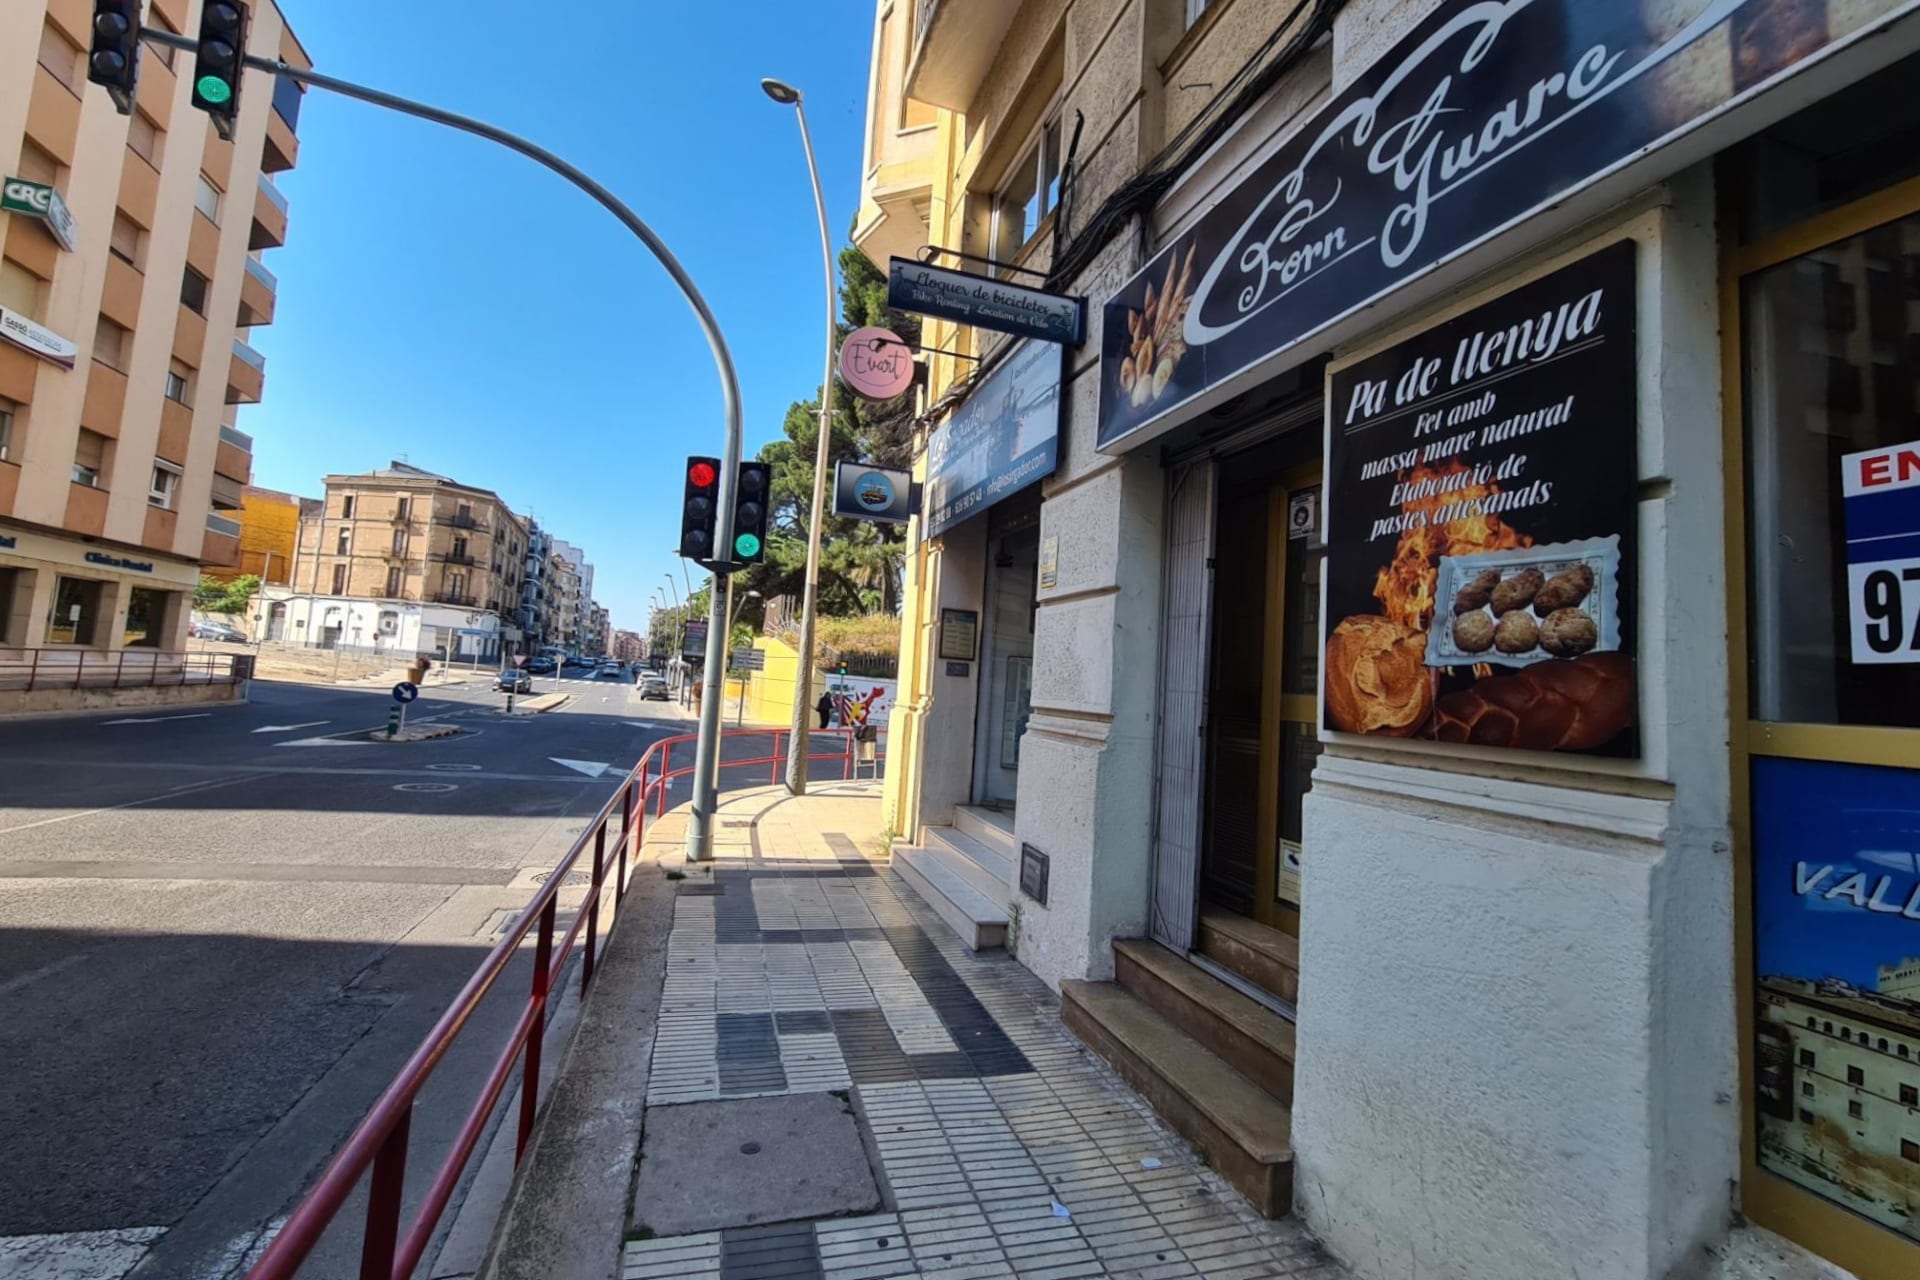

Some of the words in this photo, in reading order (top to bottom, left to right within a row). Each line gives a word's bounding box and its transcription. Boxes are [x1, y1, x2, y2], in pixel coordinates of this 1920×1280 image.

[4, 183, 49, 211] CRC
[1237, 178, 1347, 313] Forn
[972, 286, 990, 302] de
[993, 290, 1050, 314] bicicletes
[1344, 379, 1388, 425] Pa
[1395, 356, 1442, 406] de
[1450, 288, 1604, 386] llenya
[1360, 448, 1419, 481] massa
[1422, 428, 1476, 464] mare
[1480, 395, 1575, 447] natural
[1413, 408, 1444, 438] Fet
[1447, 390, 1497, 427] amb
[1389, 460, 1493, 507] Elaboració
[1496, 453, 1528, 481] de
[1369, 509, 1428, 542] pastes
[1432, 479, 1553, 525] artesanals
